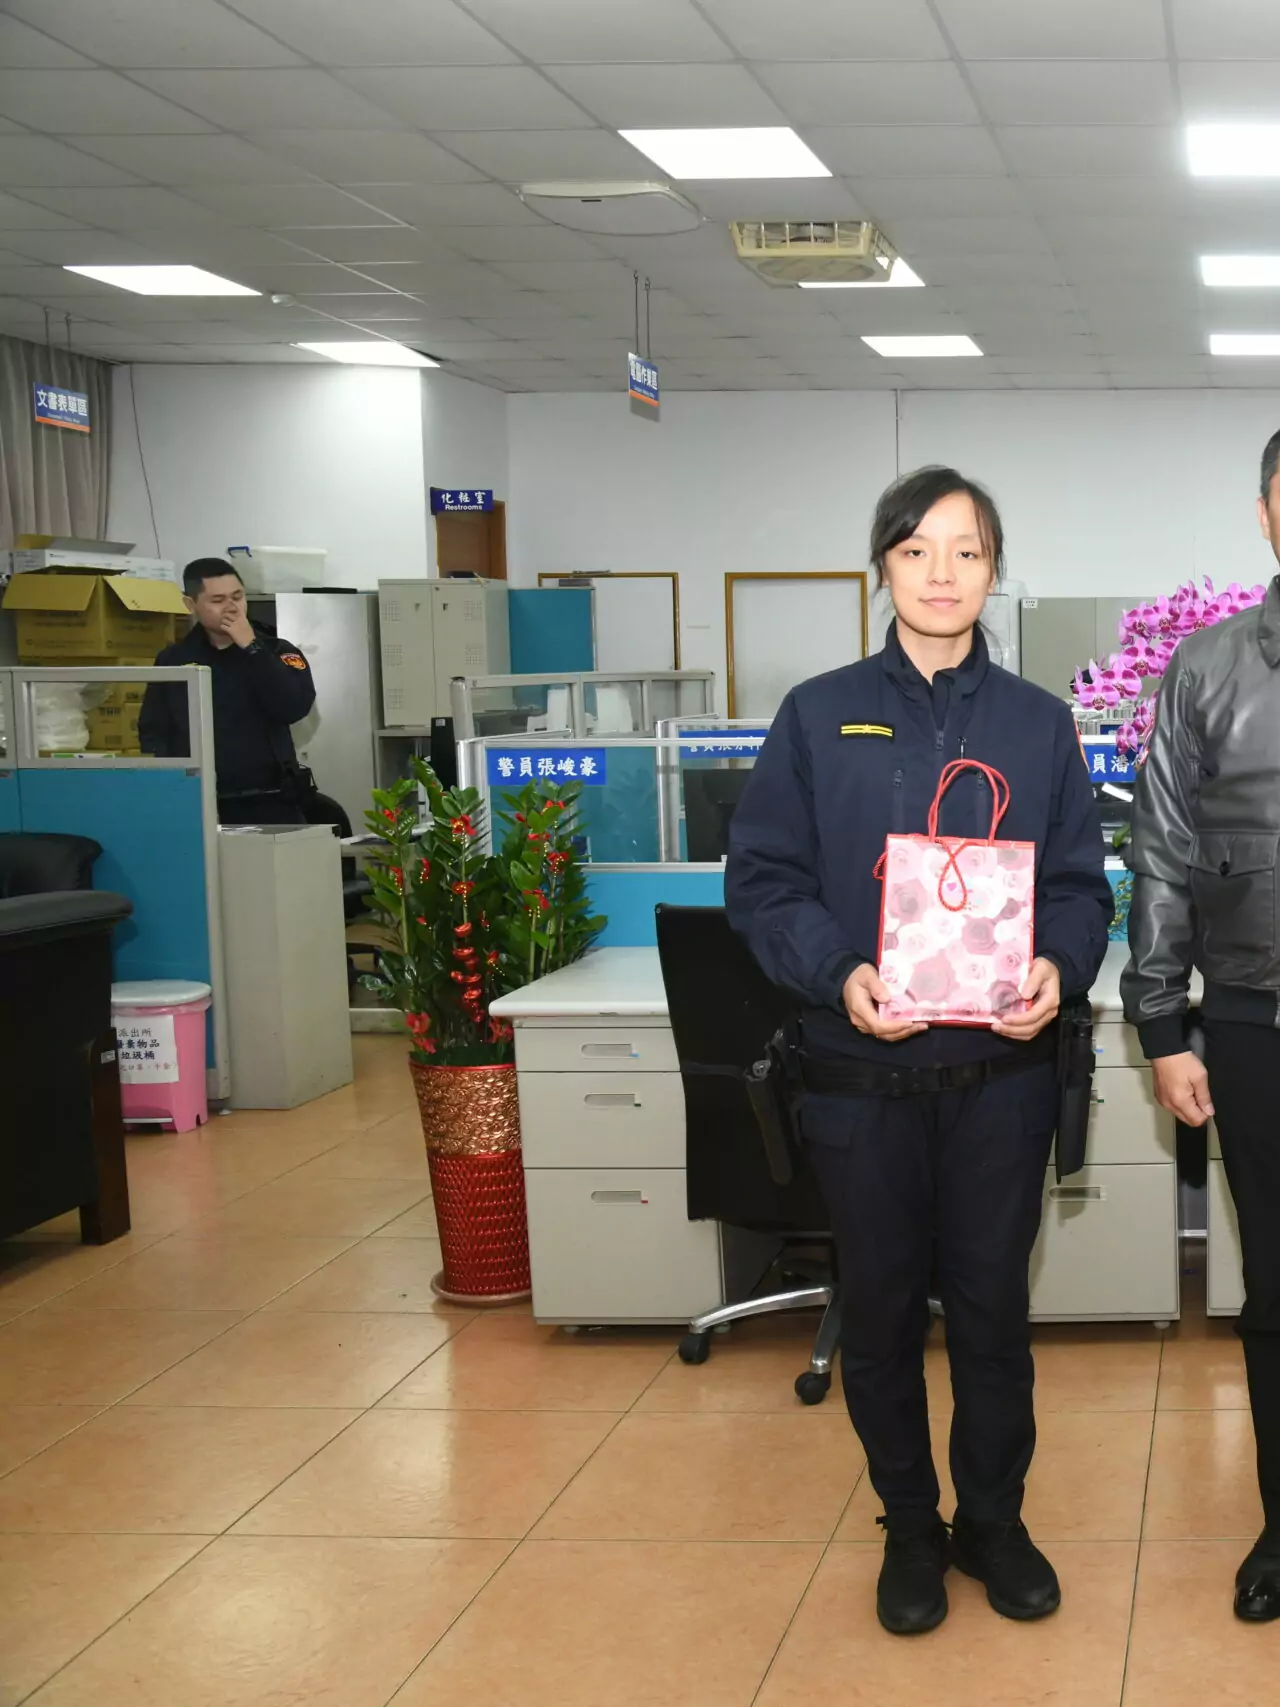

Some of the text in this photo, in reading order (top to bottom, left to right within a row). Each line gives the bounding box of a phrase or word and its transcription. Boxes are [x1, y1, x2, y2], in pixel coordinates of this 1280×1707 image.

[37, 389, 88, 417] 文書表單區
[497, 756, 599, 778] 警員張峻豪
[1092, 753, 1137, 774] 員潘
